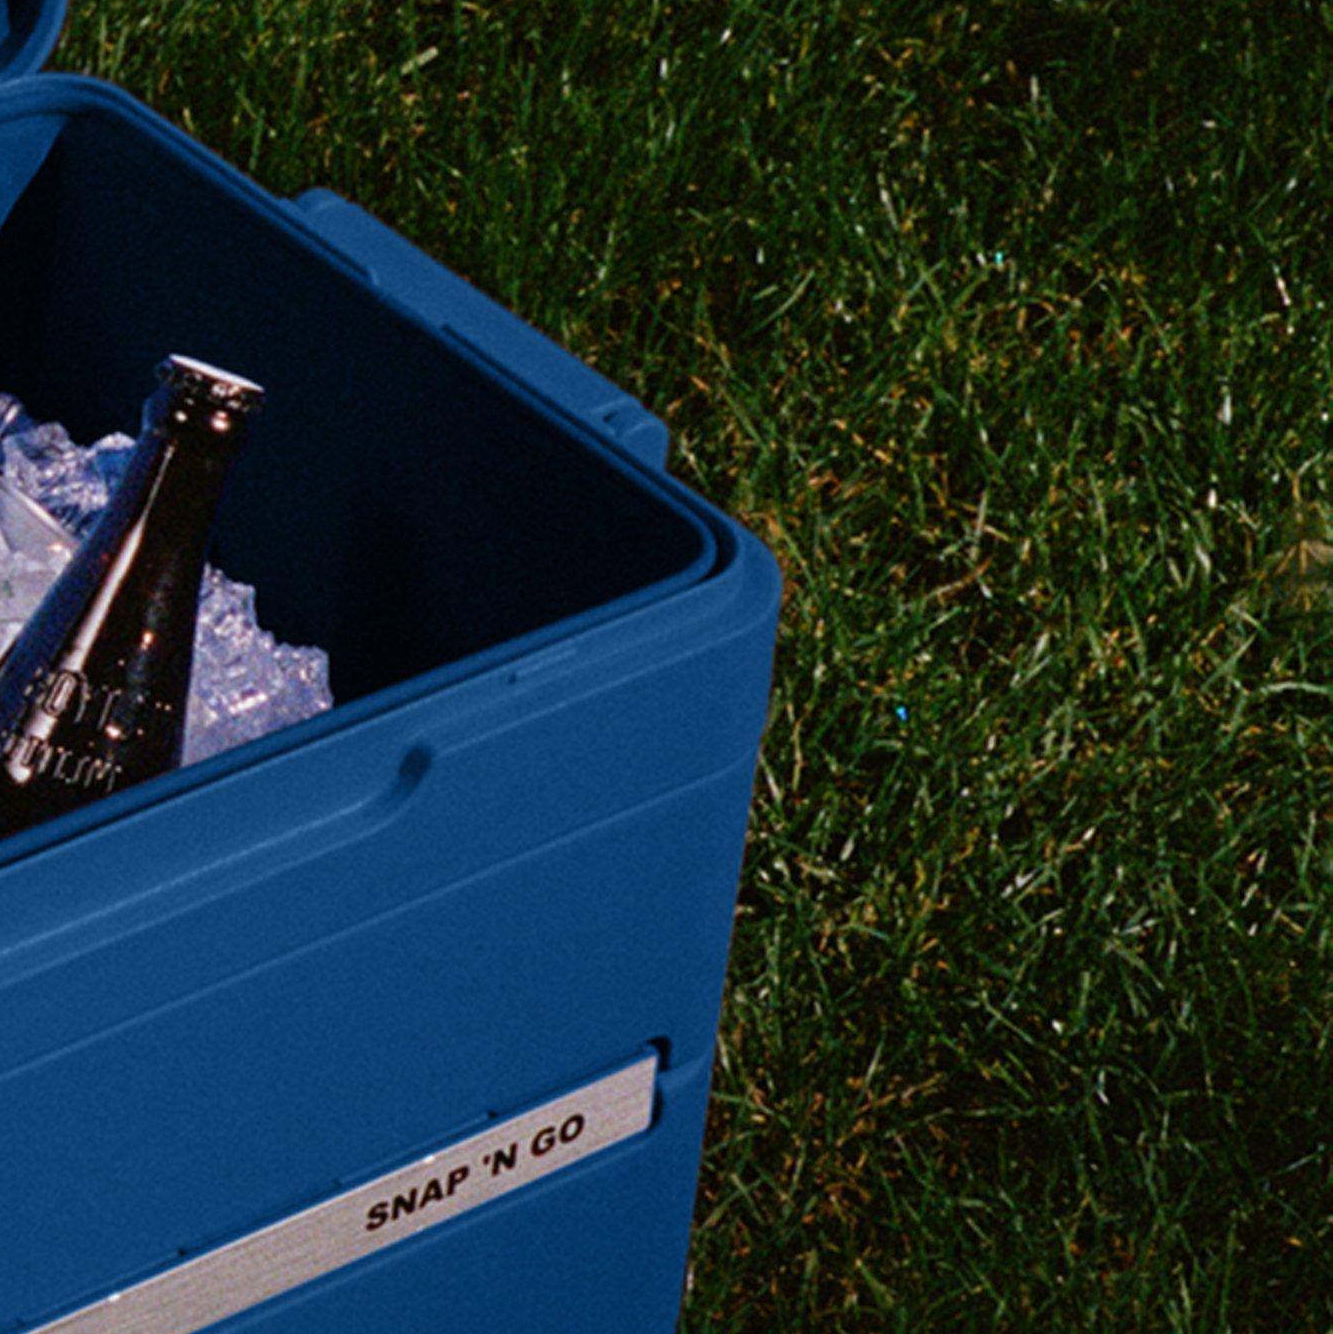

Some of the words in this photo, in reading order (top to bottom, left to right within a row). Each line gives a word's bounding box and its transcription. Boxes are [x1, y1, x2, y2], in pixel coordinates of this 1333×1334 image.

[366, 1166, 470, 1231] SNAP
[482, 1143, 519, 1177] 'N
[530, 1113, 585, 1158] GO
